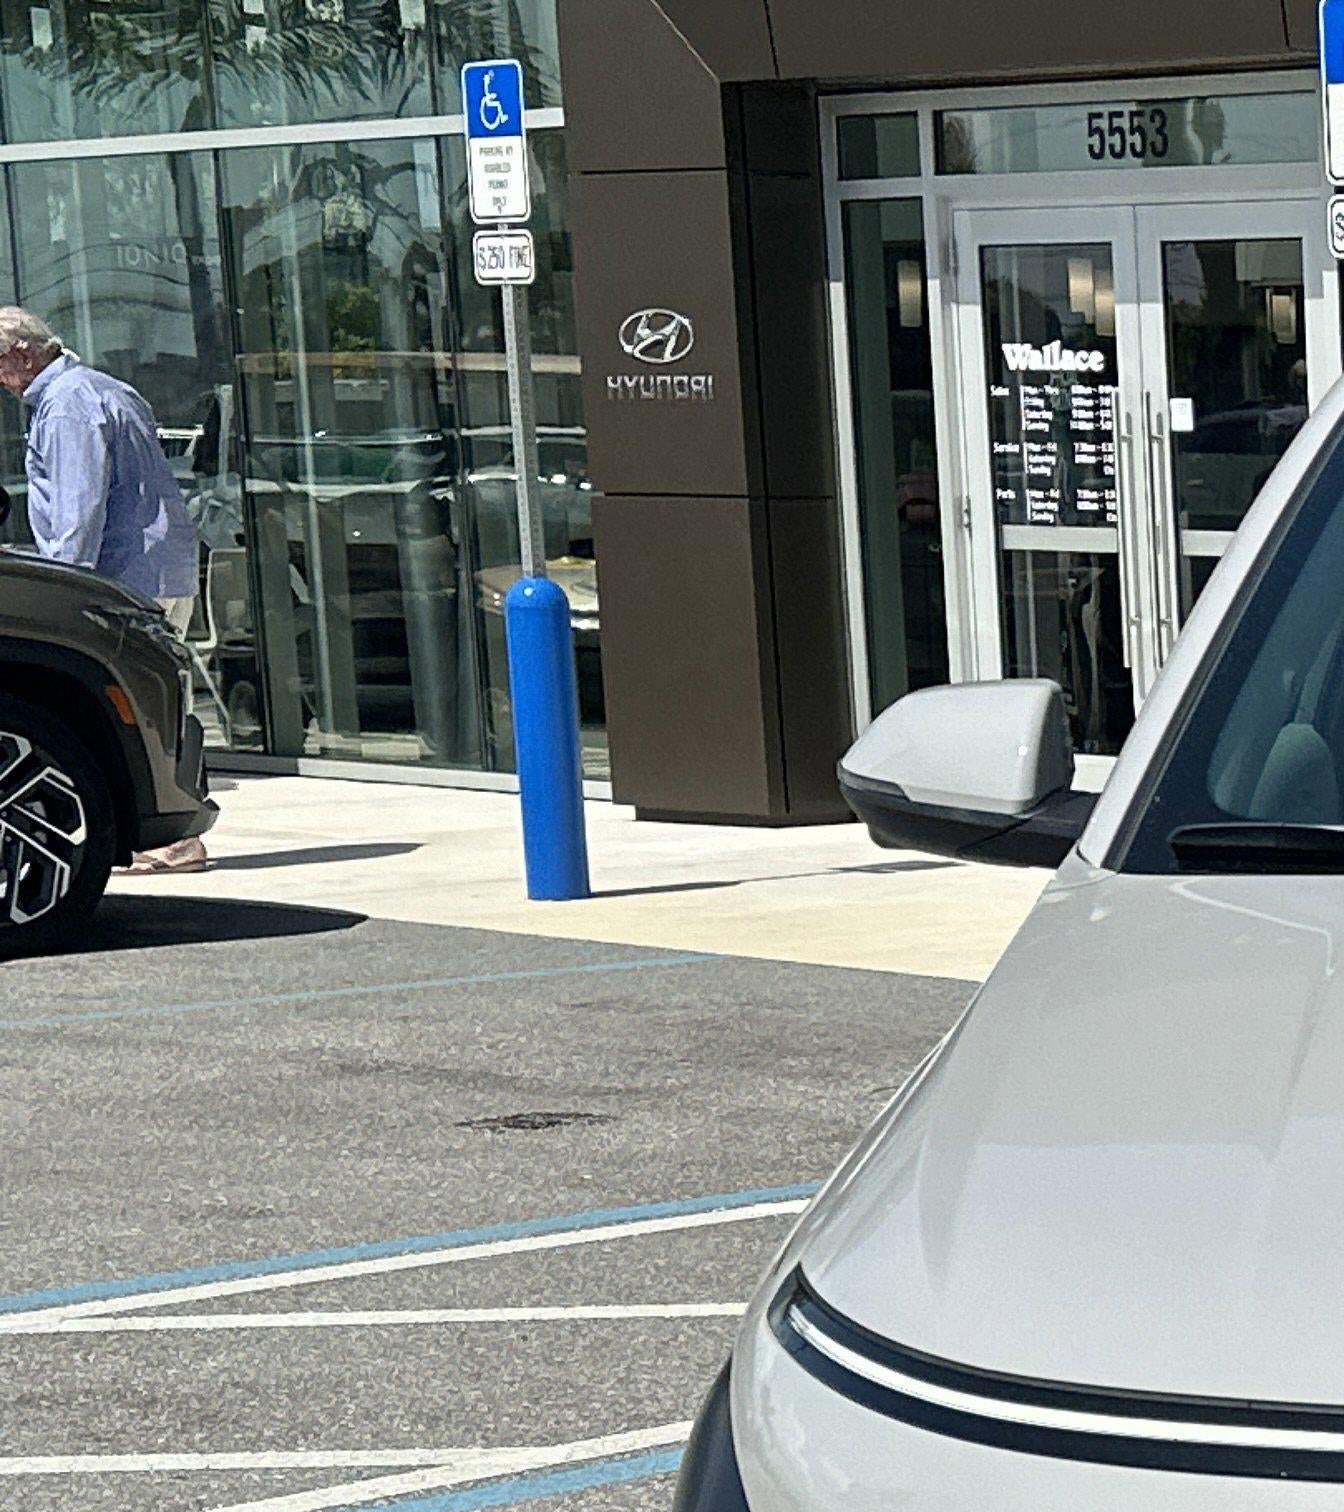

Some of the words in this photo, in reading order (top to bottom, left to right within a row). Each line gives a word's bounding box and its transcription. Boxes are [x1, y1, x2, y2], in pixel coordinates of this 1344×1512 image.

[1086, 108, 1169, 161] 5553
[1001, 339, 1105, 372] Wallace
[606, 374, 714, 400] HYUNDAI
